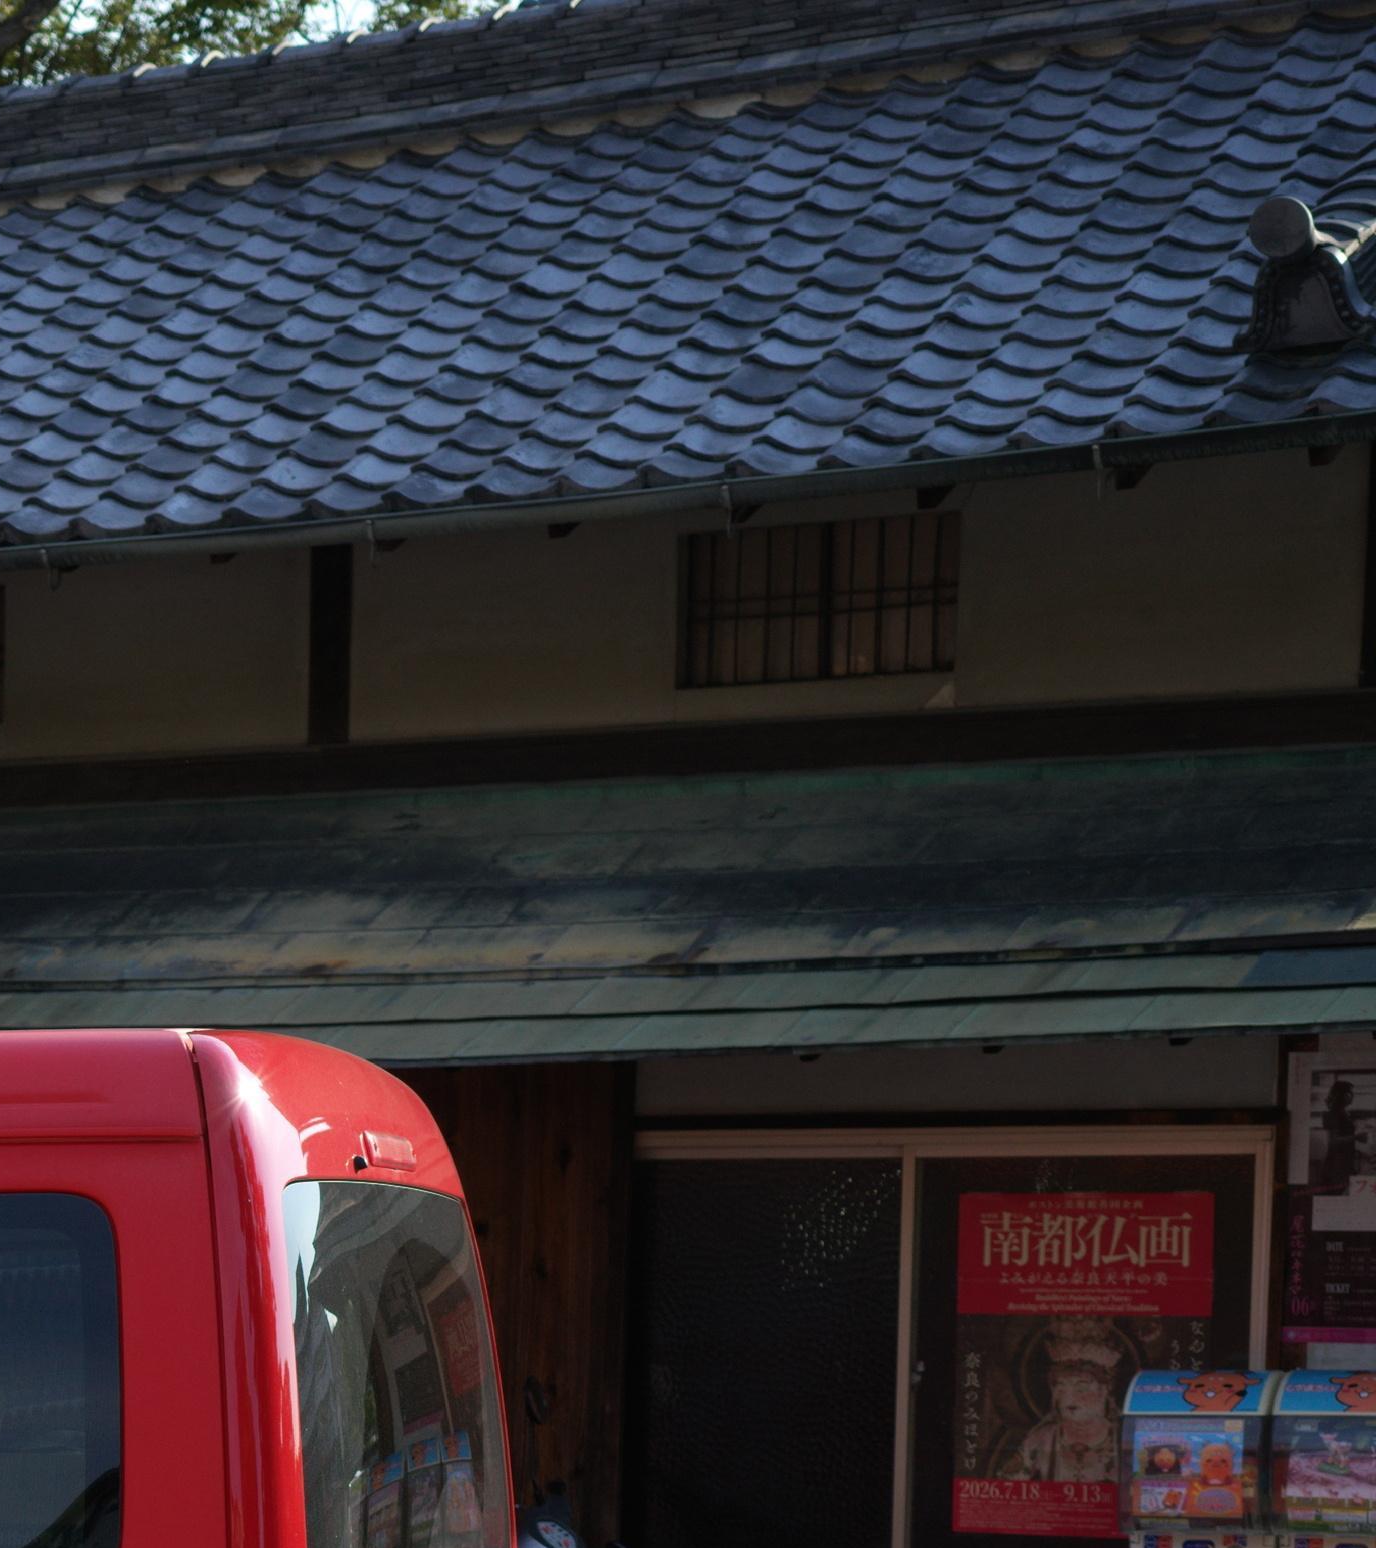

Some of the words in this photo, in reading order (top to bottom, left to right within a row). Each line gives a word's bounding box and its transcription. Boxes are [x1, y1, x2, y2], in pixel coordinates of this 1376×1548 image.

[979, 1211, 1193, 1268] 南都仏画
[1000, 1270, 1169, 1287] よみがえる奈良天平の美
[963, 1351, 981, 1470] 奈良のみほとけ
[958, 1480, 1040, 1500] 2026.7.18
